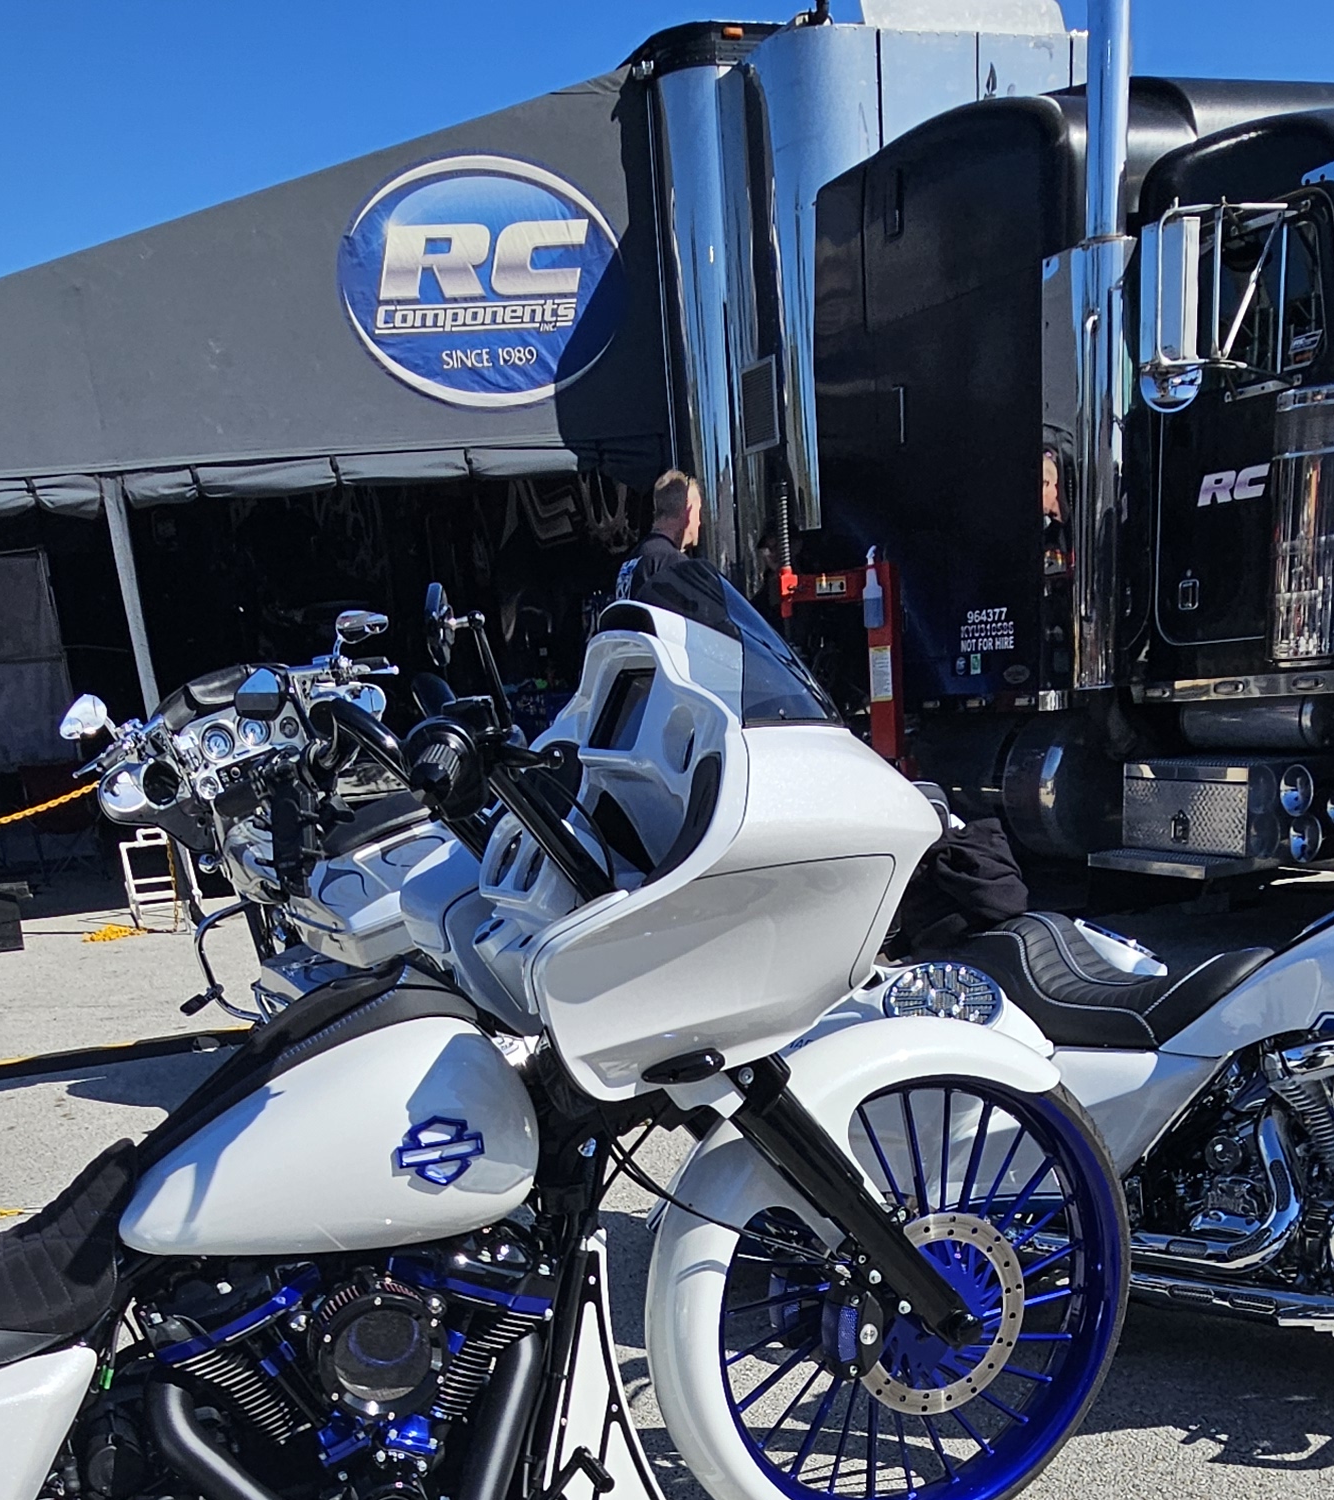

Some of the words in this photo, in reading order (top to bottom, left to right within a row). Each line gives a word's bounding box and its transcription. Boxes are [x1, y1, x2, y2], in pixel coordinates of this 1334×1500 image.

[378, 218, 589, 300] RC
[376, 300, 577, 332] Components
[442, 348, 493, 369] SINCE
[498, 346, 537, 366] 1989
[1196, 462, 1271, 508] RC
[967, 607, 1008, 624] 964377
[960, 639, 976, 653] NOT
[978, 638, 993, 651] FOR
[995, 636, 1015, 650] HIRE
